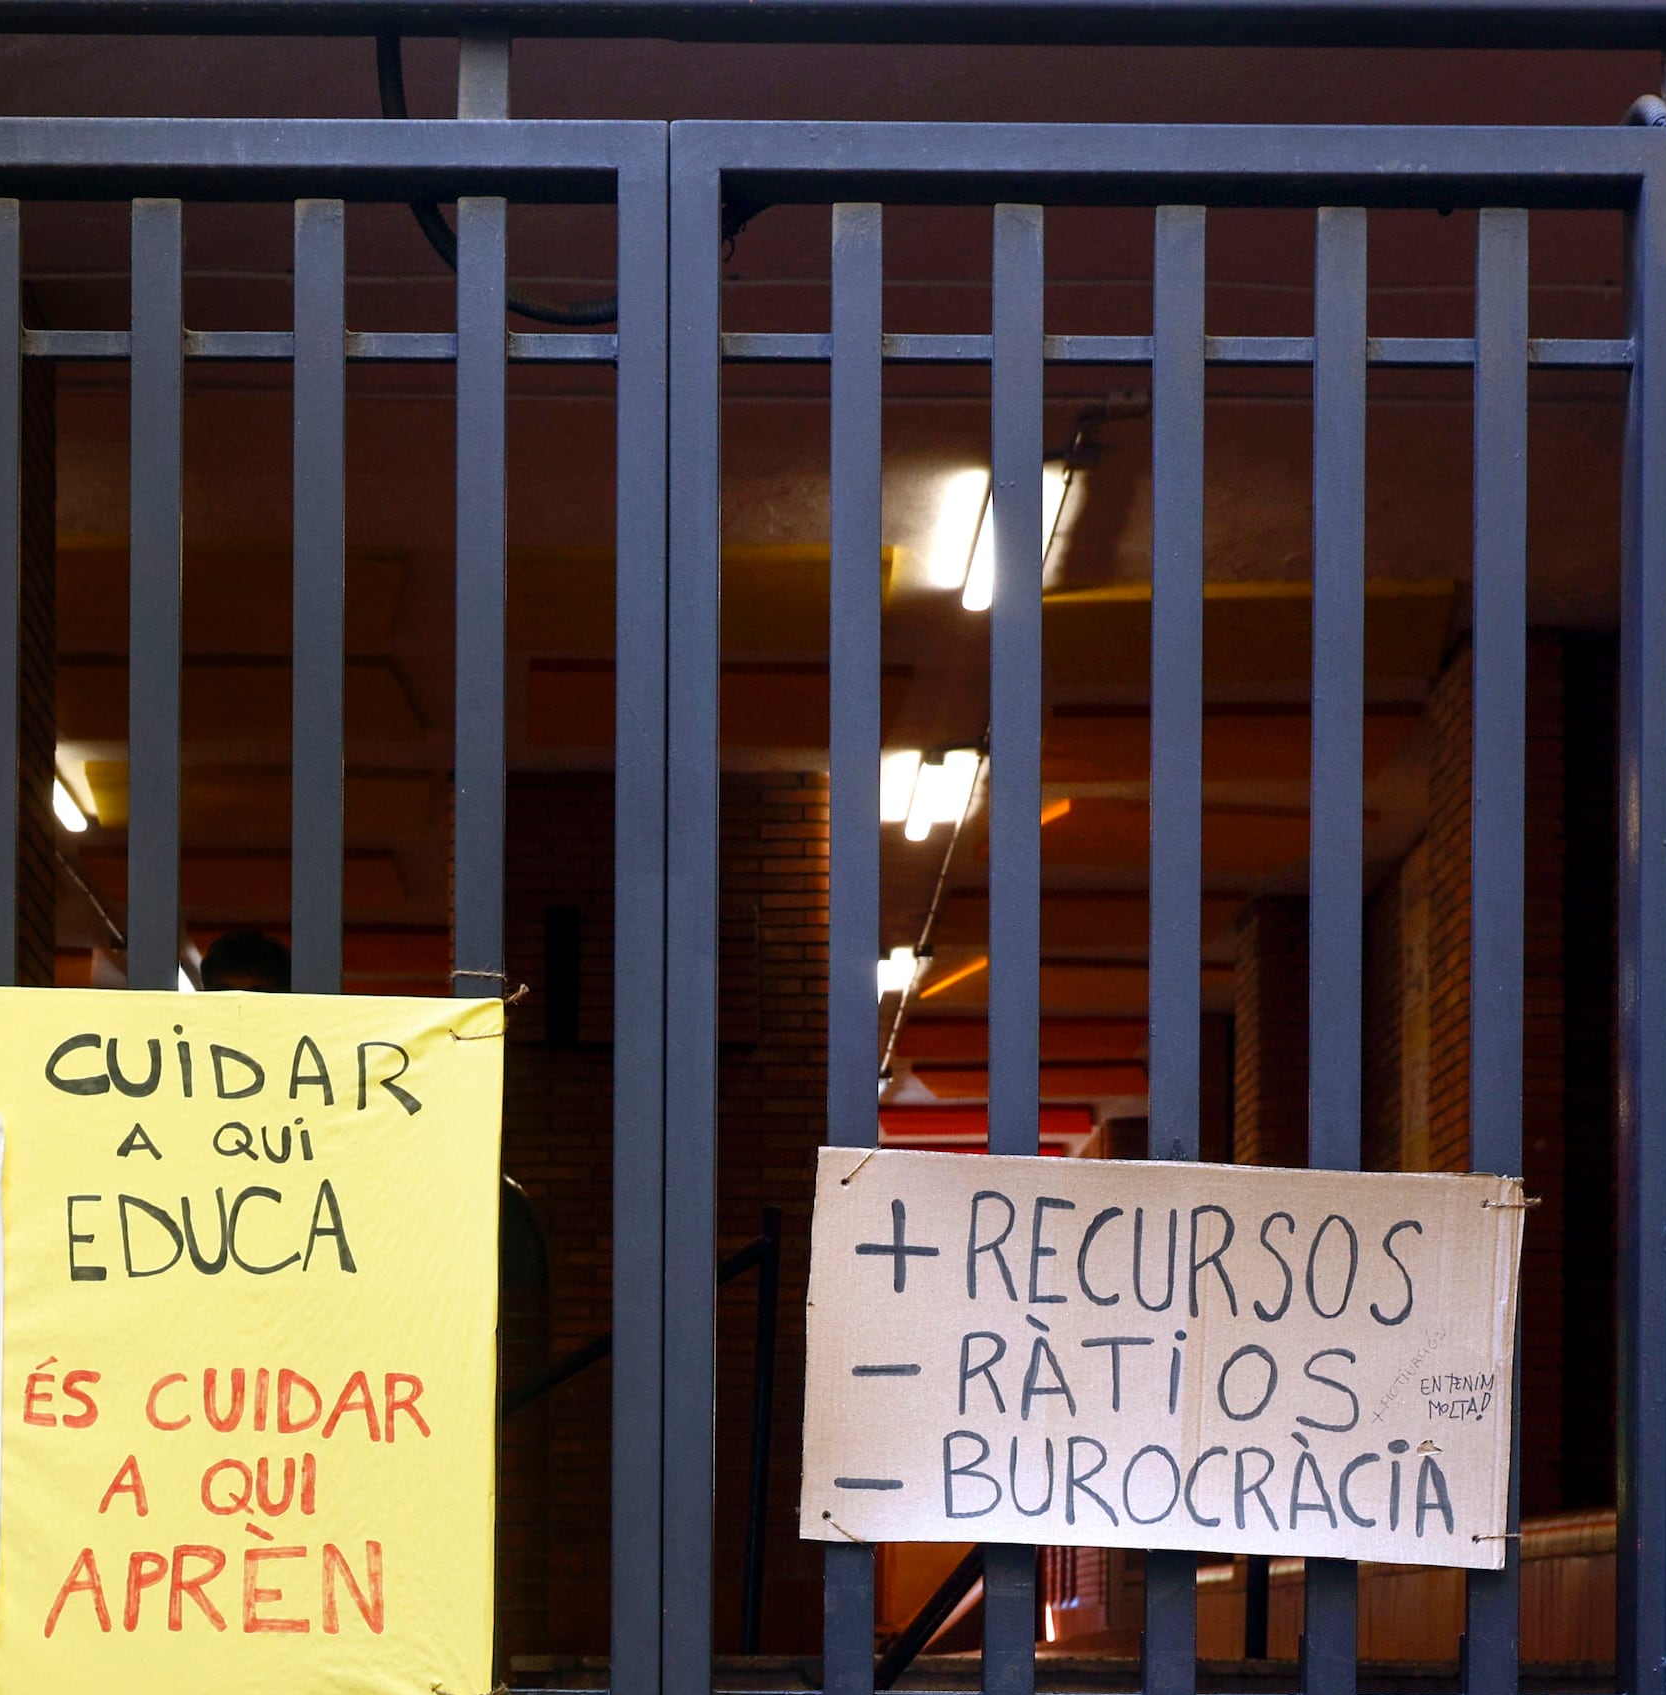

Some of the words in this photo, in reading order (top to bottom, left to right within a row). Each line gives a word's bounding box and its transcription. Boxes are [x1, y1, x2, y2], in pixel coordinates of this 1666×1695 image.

[116, 1125, 163, 1161] A
[67, 1179, 357, 1283] EDUCA
[967, 1190, 1422, 1326] RECURSOS
[23, 1356, 101, 1431] ÉS
[146, 1369, 431, 1442] CUIDAR
[1420, 1375, 1442, 1395] EN
[99, 1453, 148, 1517] A
[200, 1453, 316, 1519] QUI
[44, 1524, 386, 1640] APRÈN
